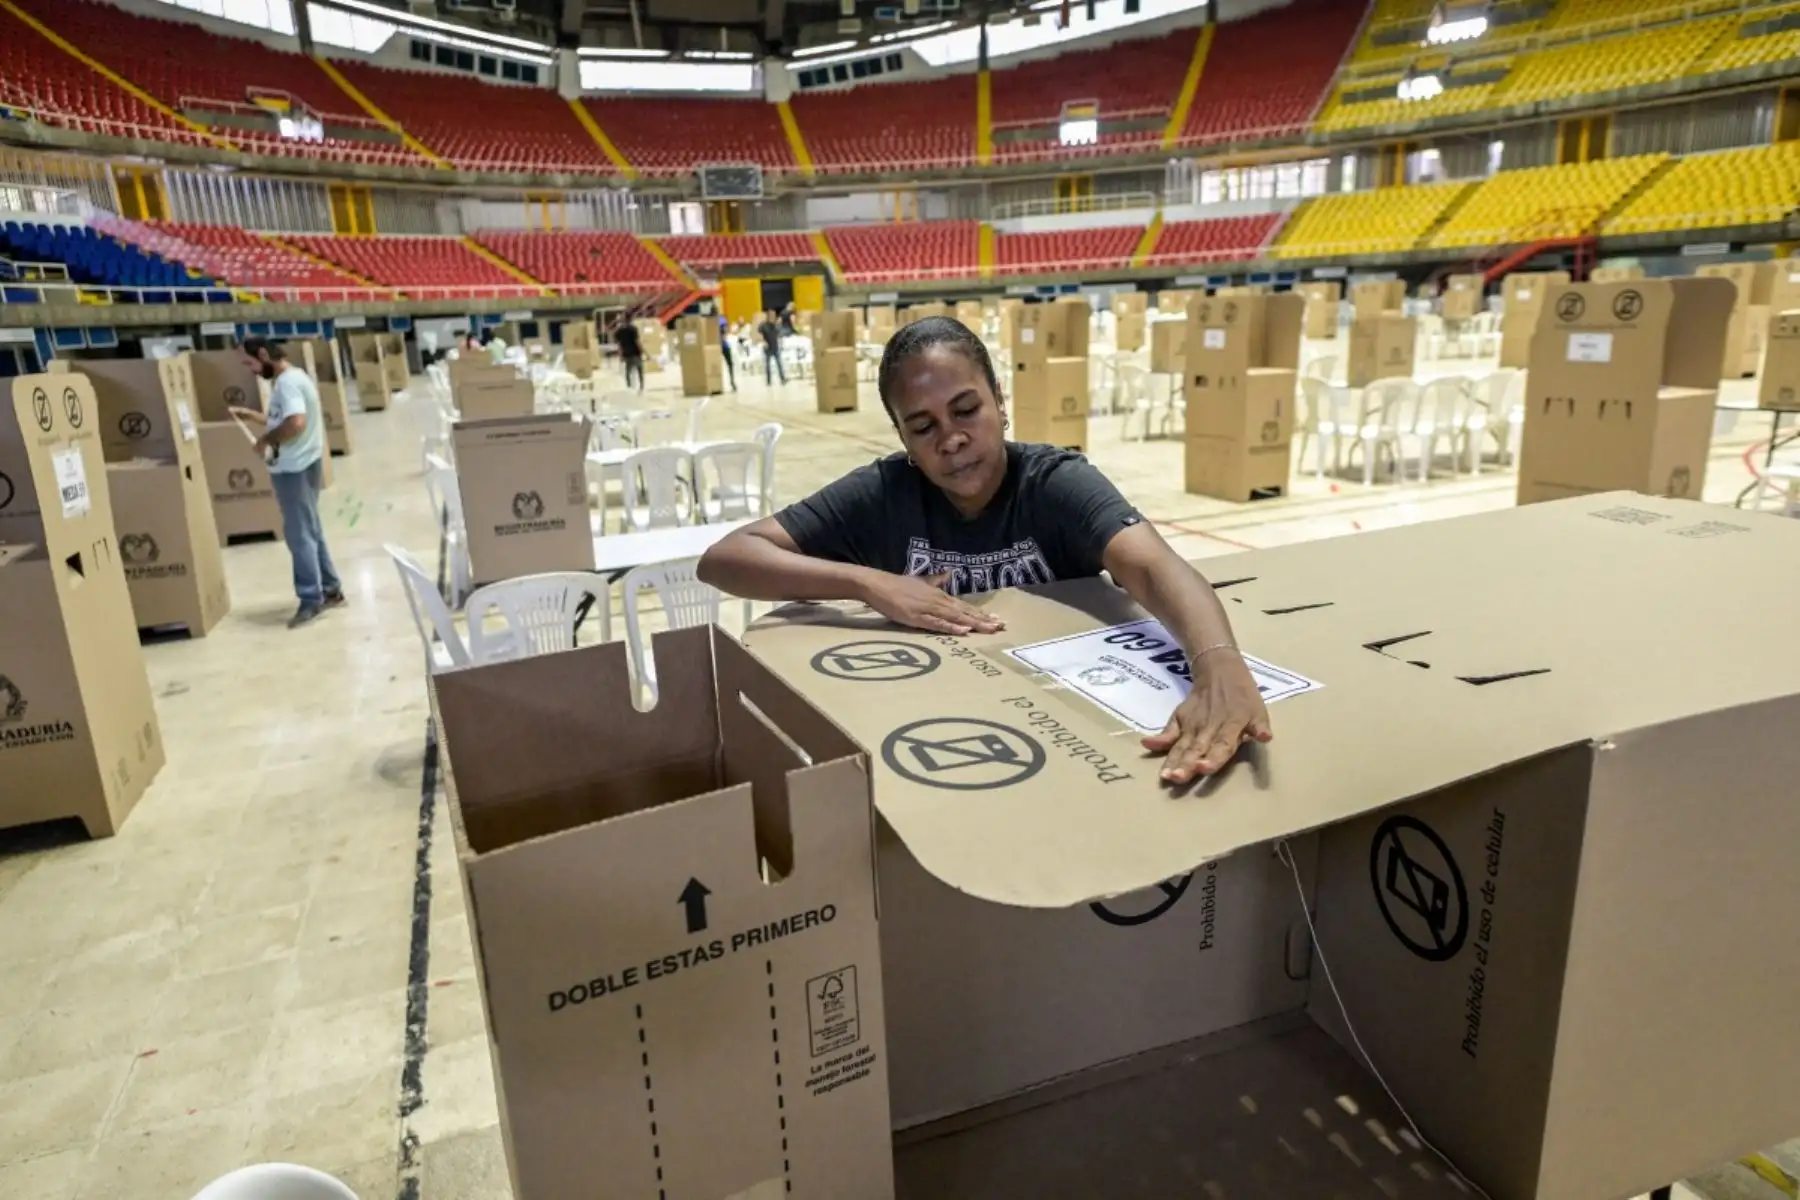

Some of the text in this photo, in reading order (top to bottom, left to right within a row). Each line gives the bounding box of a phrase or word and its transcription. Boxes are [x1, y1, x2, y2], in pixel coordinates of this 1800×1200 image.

[1104, 632, 1167, 651] 60
[950, 645, 1135, 784] Prohibido el uso de
[549, 904, 837, 1012] DOBLE ESTAS PRIMERO
[1199, 874, 1217, 951] Prohibido
[1461, 807, 1506, 1058] Prohibido el uso de celular
